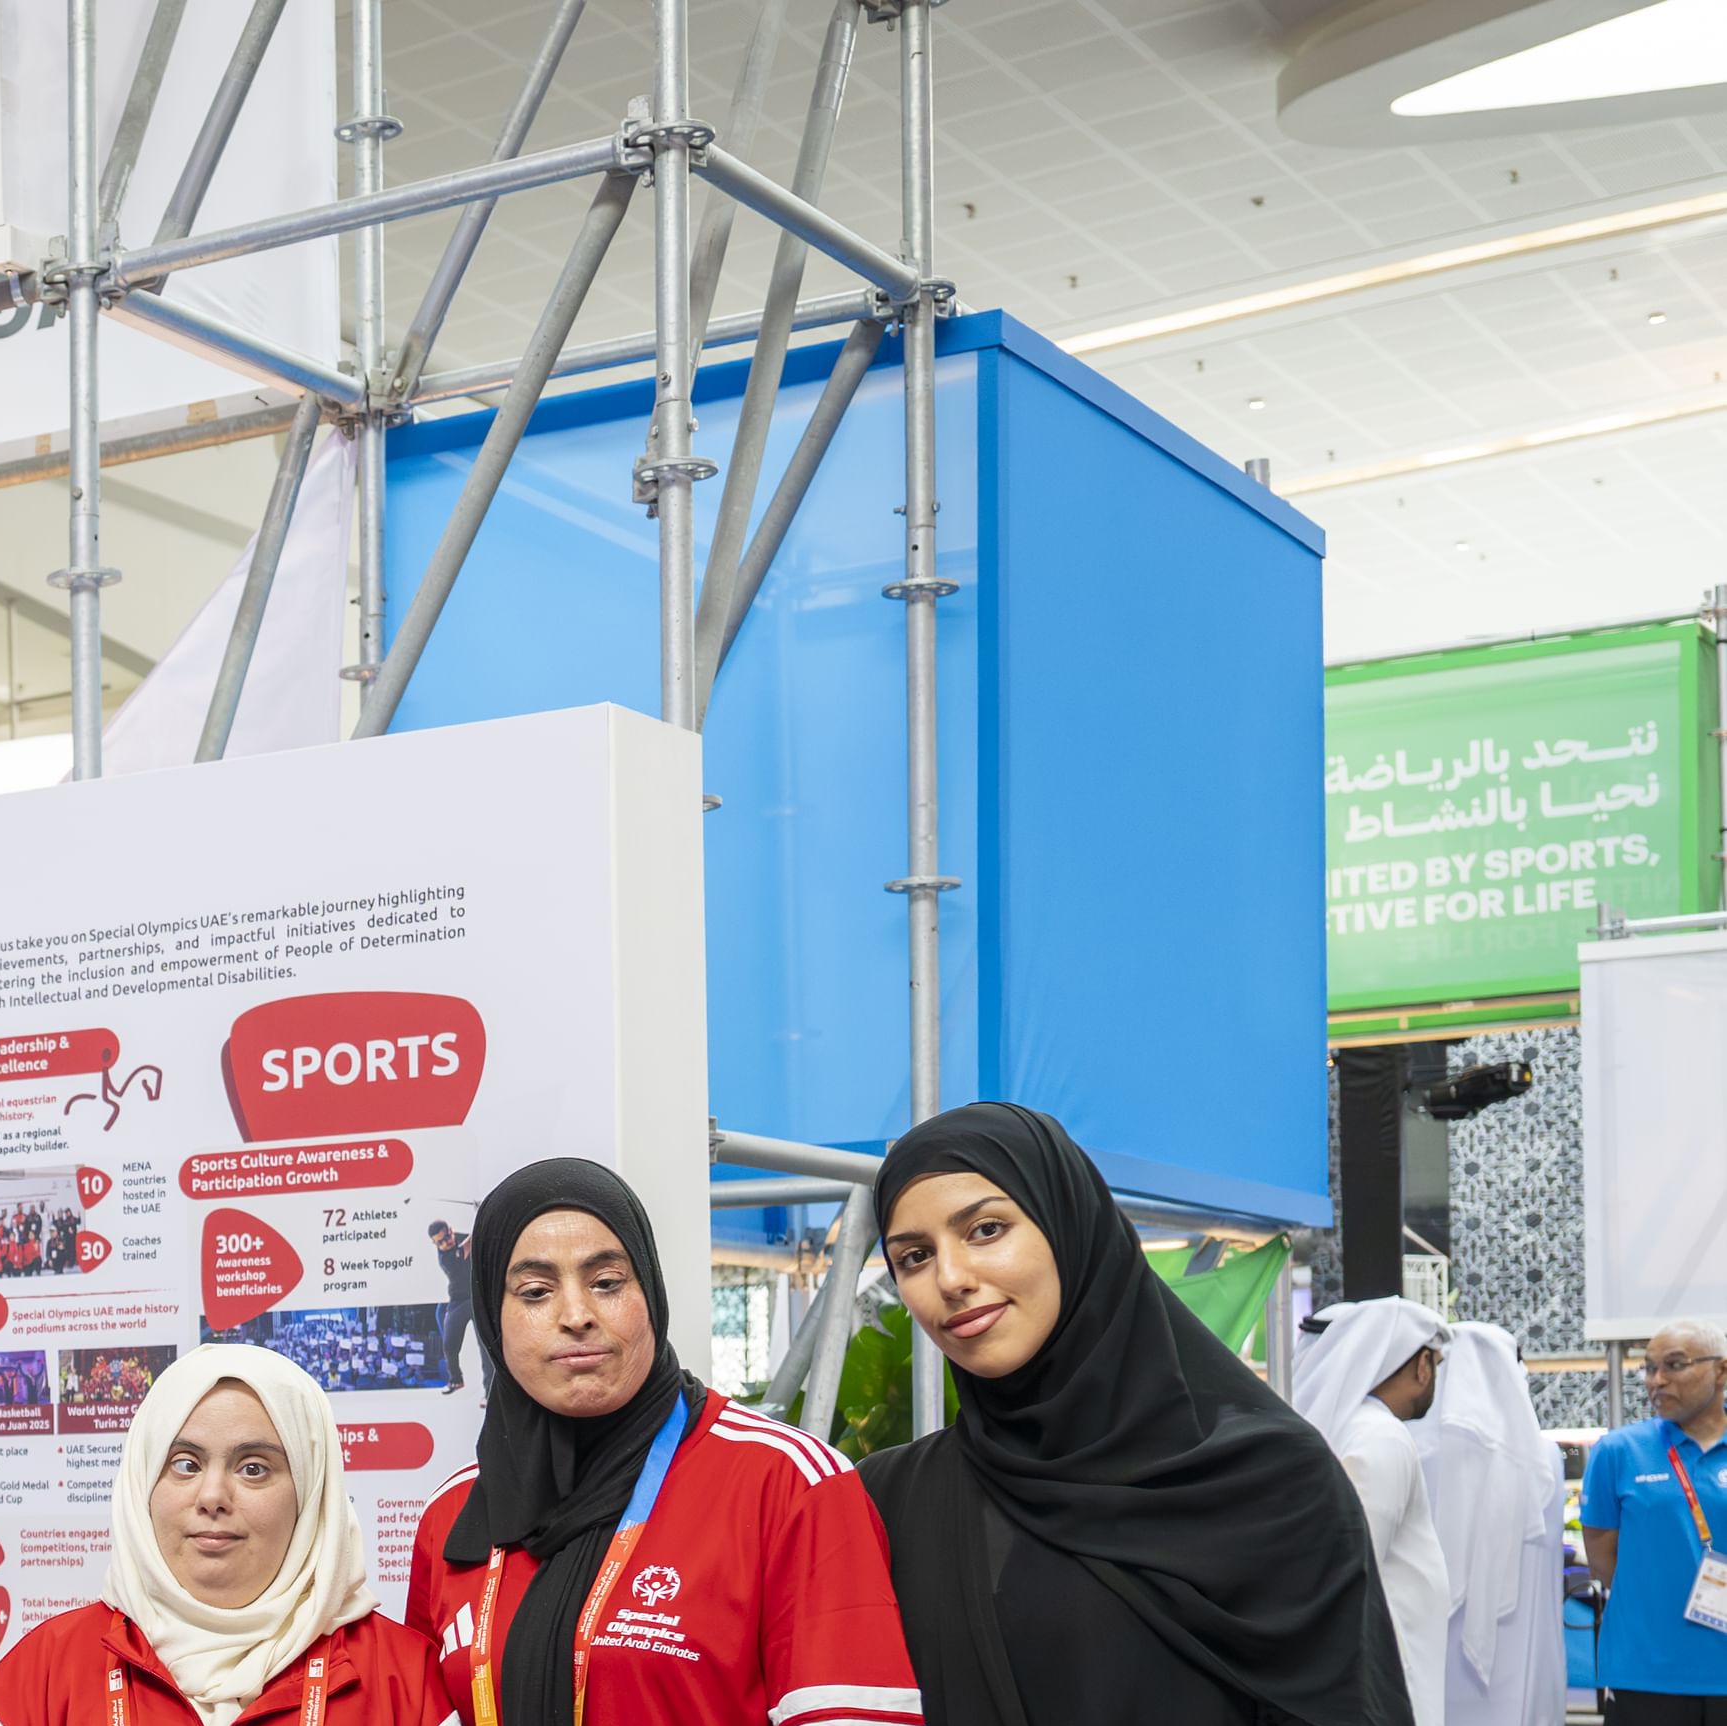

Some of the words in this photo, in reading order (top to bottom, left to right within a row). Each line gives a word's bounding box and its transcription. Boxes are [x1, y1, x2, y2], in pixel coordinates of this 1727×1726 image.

[1326, 860, 1420, 899] ITED
[1425, 853, 1474, 888] BY
[1484, 834, 1660, 881] SPORTS,
[1326, 897, 1418, 934] TIVE
[1424, 890, 1506, 925] FOR
[1513, 877, 1596, 918] LIFE
[0, 940, 13, 952] us
[16, 935, 43, 951] take
[46, 935, 68, 949] you
[71, 932, 86, 944] on
[89, 924, 135, 943] Special
[137, 918, 197, 937] Olympics
[241, 902, 319, 924] remarkable
[320, 896, 375, 917] journey
[378, 885, 465, 908] highlighting
[79, 941, 164, 964] partnerships,
[176, 935, 199, 950] and
[211, 927, 275, 948] impactful
[287, 919, 355, 938] initiatives
[367, 907, 437, 929] dedicated
[451, 906, 465, 919] to
[42, 971, 62, 984] the
[68, 964, 125, 983] inclusion
[131, 960, 154, 975] and
[160, 950, 259, 972] empowerment
[265, 946, 279, 960] of
[285, 939, 333, 959] People
[339, 937, 354, 951] of
[361, 925, 465, 950] Determination
[9, 983, 81, 1006] Intellectual
[85, 984, 108, 999] and
[113, 974, 213, 996] Developmental
[218, 965, 297, 985] Disabilities.
[59, 1036, 69, 1048] &
[262, 1032, 460, 1092] SPORTS
[192, 1156, 237, 1174] Sports
[240, 1152, 293, 1169] Culture
[297, 1146, 374, 1165] Awareness
[378, 1144, 388, 1158] &
[81, 1175, 103, 1195] 10
[123, 1161, 152, 1172] MENA
[192, 1174, 282, 1192] Participation
[286, 1167, 339, 1185] Growth
[323, 1209, 346, 1227] 72
[352, 1209, 398, 1222] Athletes
[216, 1234, 264, 1254] 300+
[323, 1228, 386, 1244] participated
[81, 1241, 104, 1261] 30
[122, 1235, 162, 1247] Coaches
[123, 1249, 157, 1261] trained
[216, 1255, 271, 1268] Awareness
[323, 1258, 334, 1276] 8
[340, 1260, 369, 1271] Week
[372, 1257, 413, 1271] Topgolf
[216, 1270, 266, 1282] workshop
[323, 1280, 367, 1293] program
[217, 1284, 282, 1297] beneficiaries
[616, 1608, 681, 1627] Special
[606, 1621, 686, 1642] Olympics
[590, 1635, 623, 1649] United
[624, 1636, 650, 1651] Arab
[652, 1643, 700, 1662] Emirates
